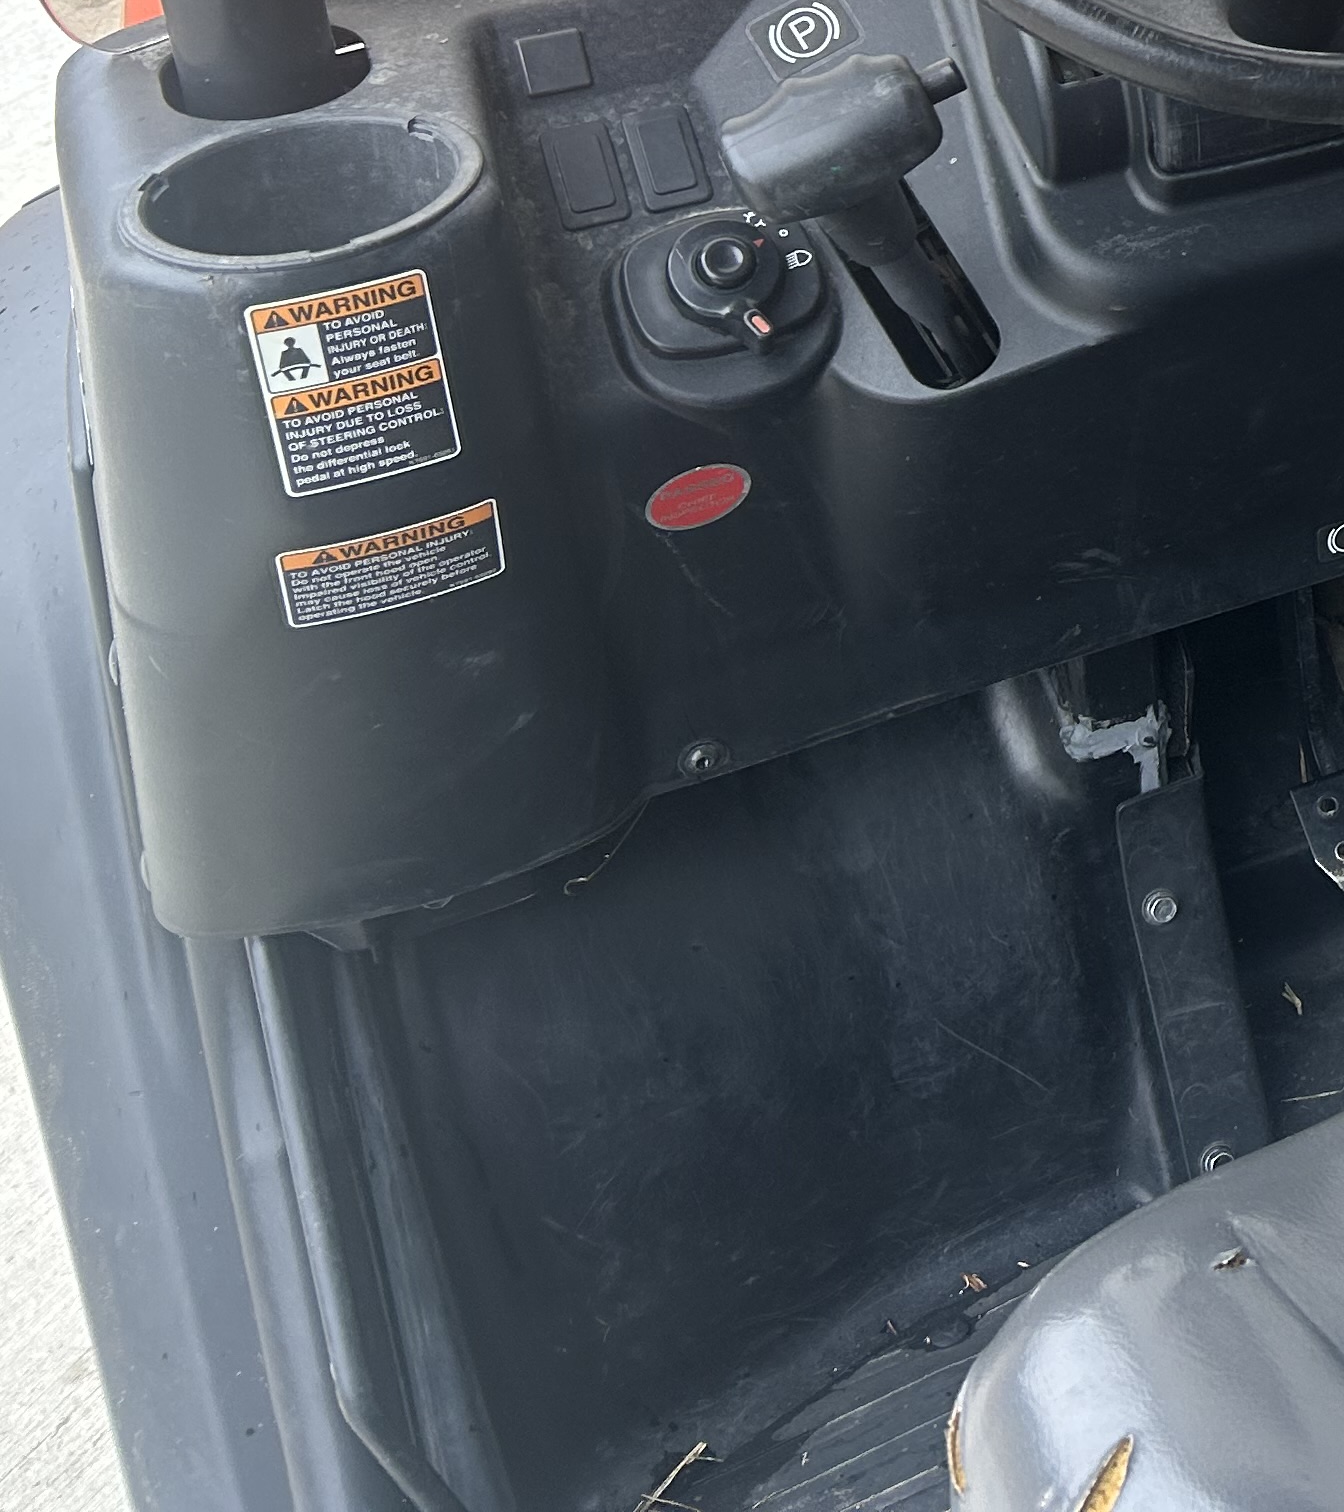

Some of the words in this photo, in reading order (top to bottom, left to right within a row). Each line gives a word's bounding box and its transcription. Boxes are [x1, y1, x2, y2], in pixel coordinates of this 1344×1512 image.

[788, 15, 815, 50] P
[289, 280, 417, 320] WARNING
[323, 319, 340, 330] TO
[344, 309, 384, 326] AVOID
[325, 319, 396, 342] PERSONAL
[327, 338, 366, 354] INJURY
[369, 333, 386, 344] OR
[331, 349, 375, 365] Always
[378, 338, 416, 354] fasten
[333, 364, 361, 378] your
[365, 356, 390, 369] seat
[308, 364, 434, 408] WARNING
[281, 418, 301, 428] TO
[304, 409, 344, 425] AVOID
[347, 391, 417, 415] PERSONAL
[285, 423, 331, 440] INJURY
[335, 416, 363, 429] DUE
[365, 411, 384, 422] TO
[386, 401, 421, 416] LOSS
[287, 440, 307, 451] OF
[309, 425, 375, 448] STEERING
[290, 453, 308, 463] Do
[311, 448, 332, 459] not
[335, 436, 384, 453] depress
[293, 464, 313, 474] the
[316, 447, 381, 469] differential
[384, 440, 410, 453] lock
[296, 471, 330, 487] pedal
[332, 468, 345, 477] at
[347, 461, 375, 474] high
[378, 450, 417, 466] speed.
[339, 515, 466, 559] WARNING
[309, 574, 331, 582] not
[336, 565, 380, 579] operate
[403, 546, 446, 562] vehicle
[312, 563, 350, 576] AVOID
[355, 546, 423, 567] PERSONAL
[351, 575, 400, 590] visibility
[403, 570, 414, 579] of
[418, 564, 435, 573] the
[439, 546, 486, 567] operator
[293, 584, 318, 594] with
[321, 579, 341, 588] the
[344, 573, 372, 585] front
[376, 565, 405, 576] hood
[296, 596, 321, 607] may
[391, 581, 403, 589] of
[406, 568, 446, 585] vehicle
[334, 598, 352, 606] the
[356, 590, 387, 602] hood
[390, 573, 438, 595] securely
[299, 606, 355, 622] operating
[359, 599, 377, 608] the
